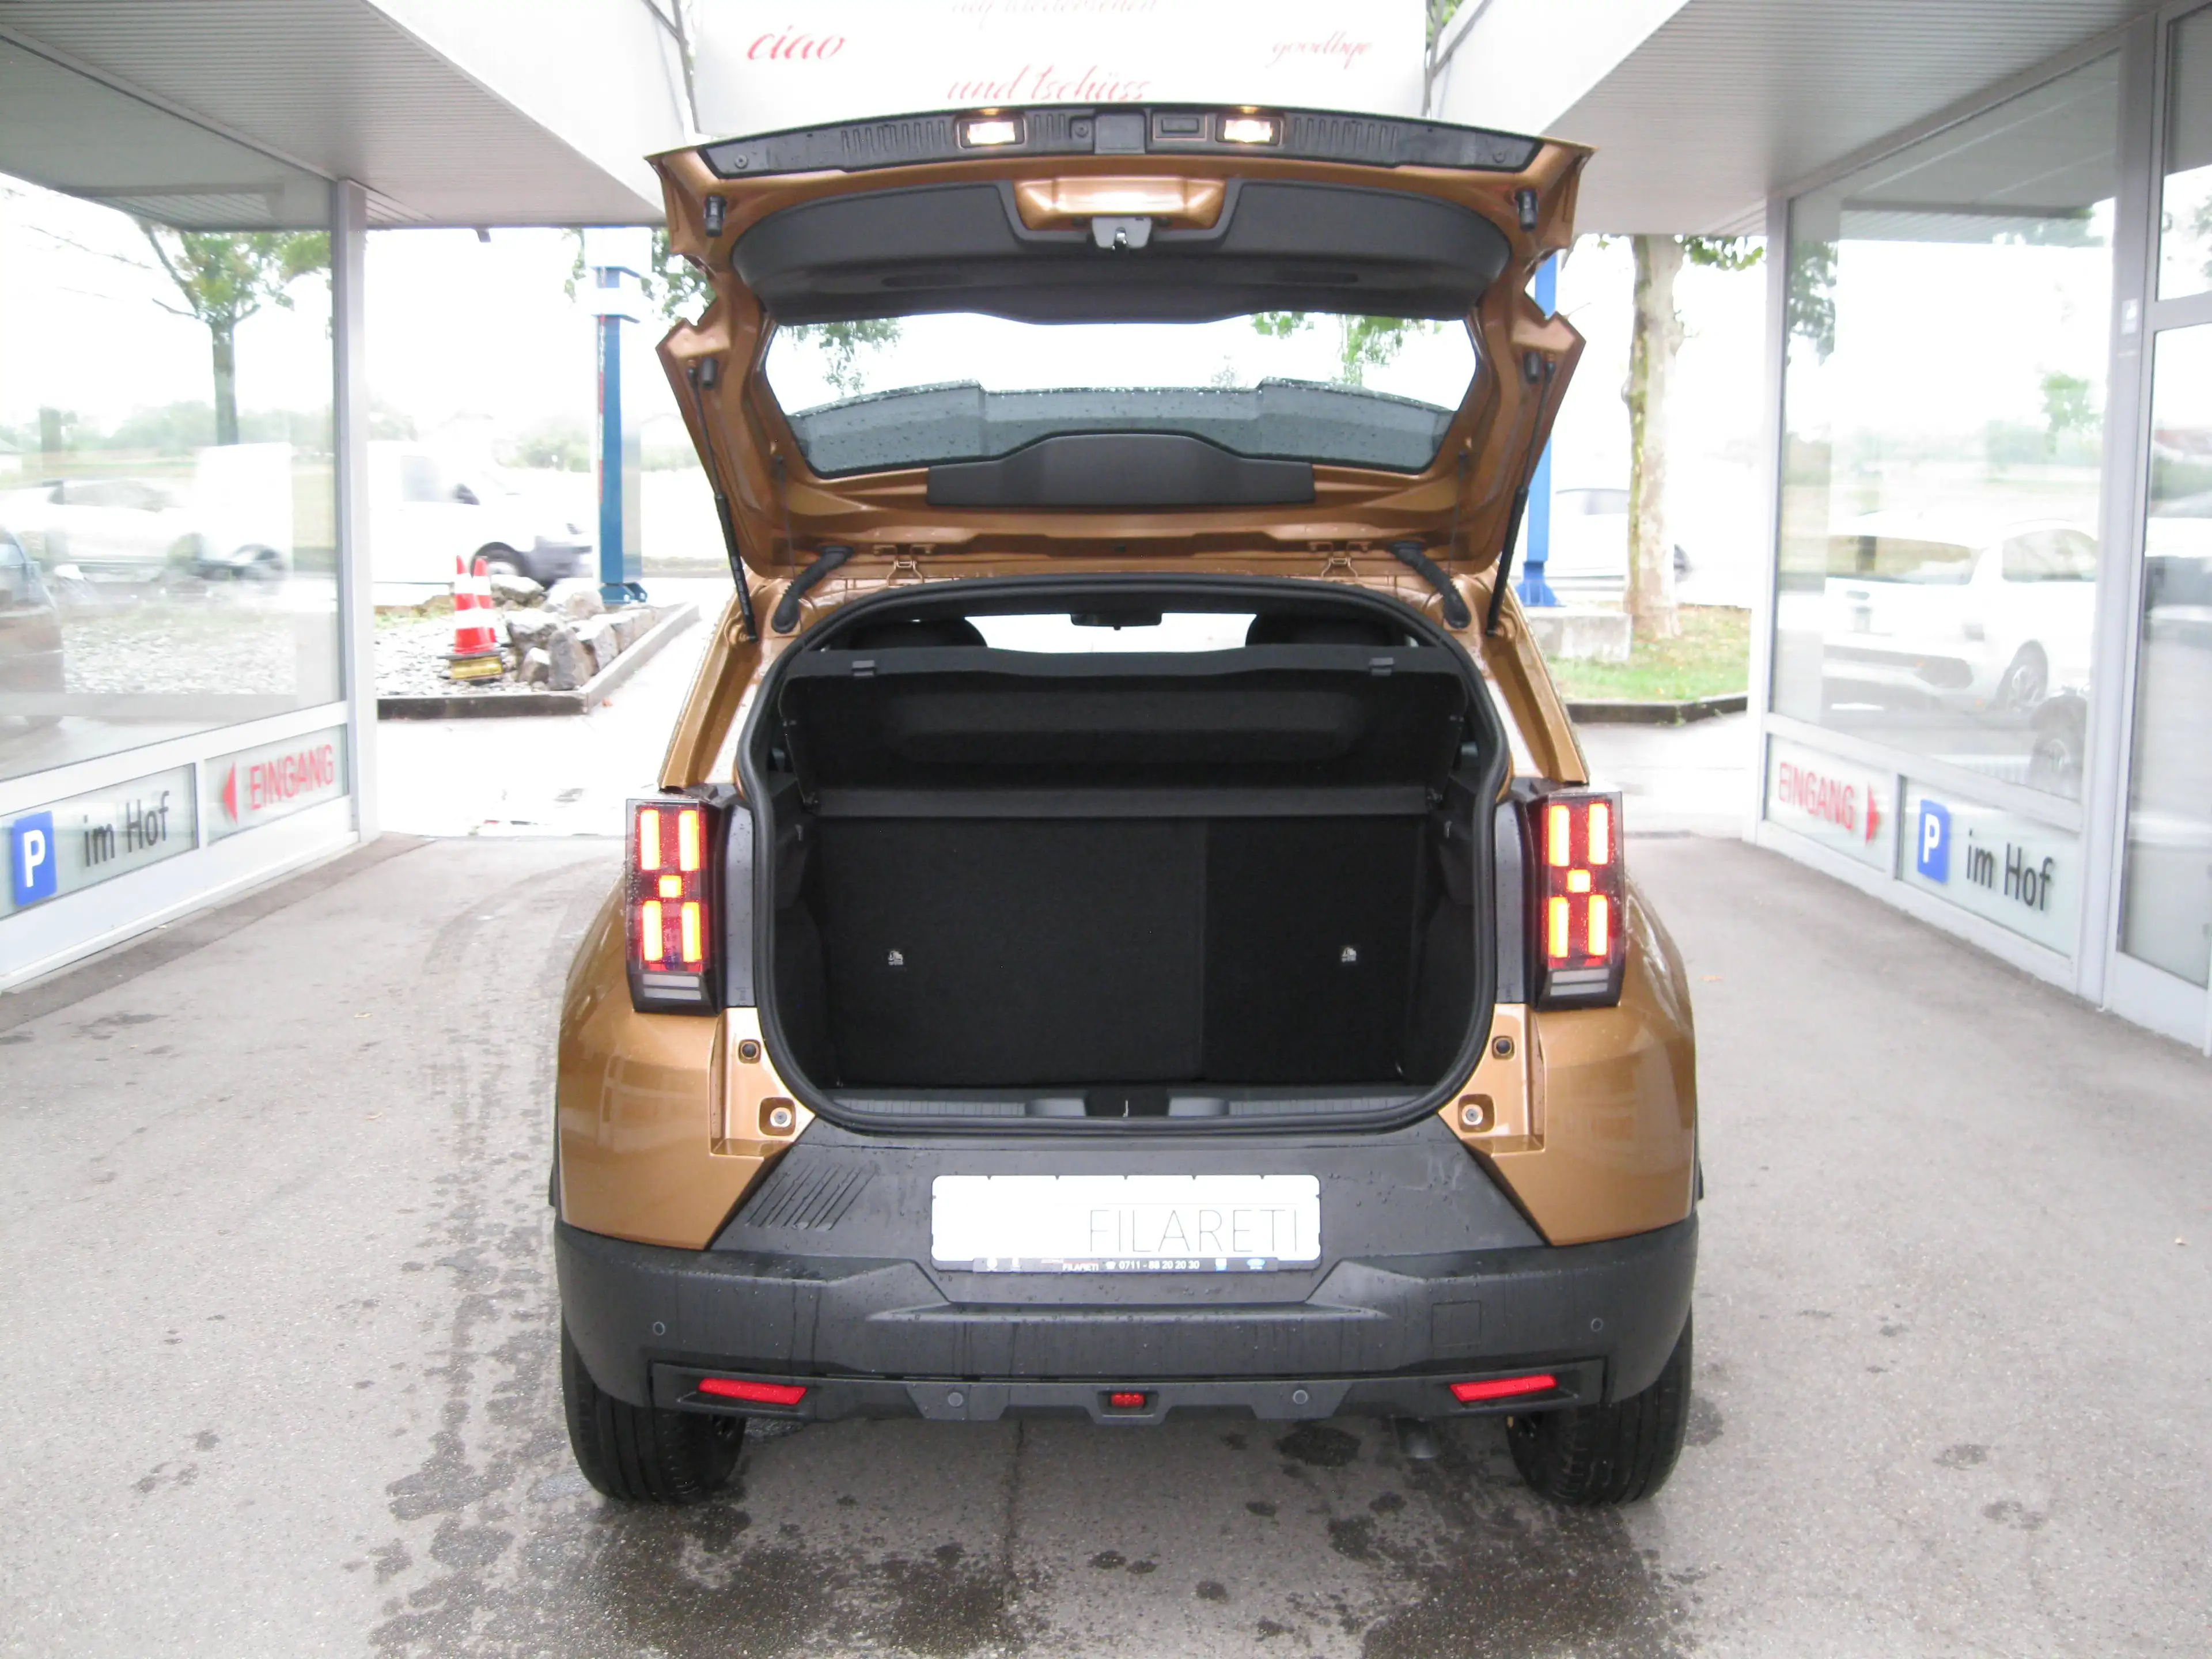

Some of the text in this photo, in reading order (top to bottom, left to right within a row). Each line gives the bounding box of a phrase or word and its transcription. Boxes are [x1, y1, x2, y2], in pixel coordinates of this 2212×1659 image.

[747, 25, 846, 60] ciao
[946, 64, 1030, 100] und
[249, 744, 334, 810] EINGANG
[1779, 762, 1855, 830] EINGANG
[24, 790, 170, 887] P im Hof
[1923, 813, 2056, 911] P im Hof
[1090, 1210, 1297, 1252] FILARETI
